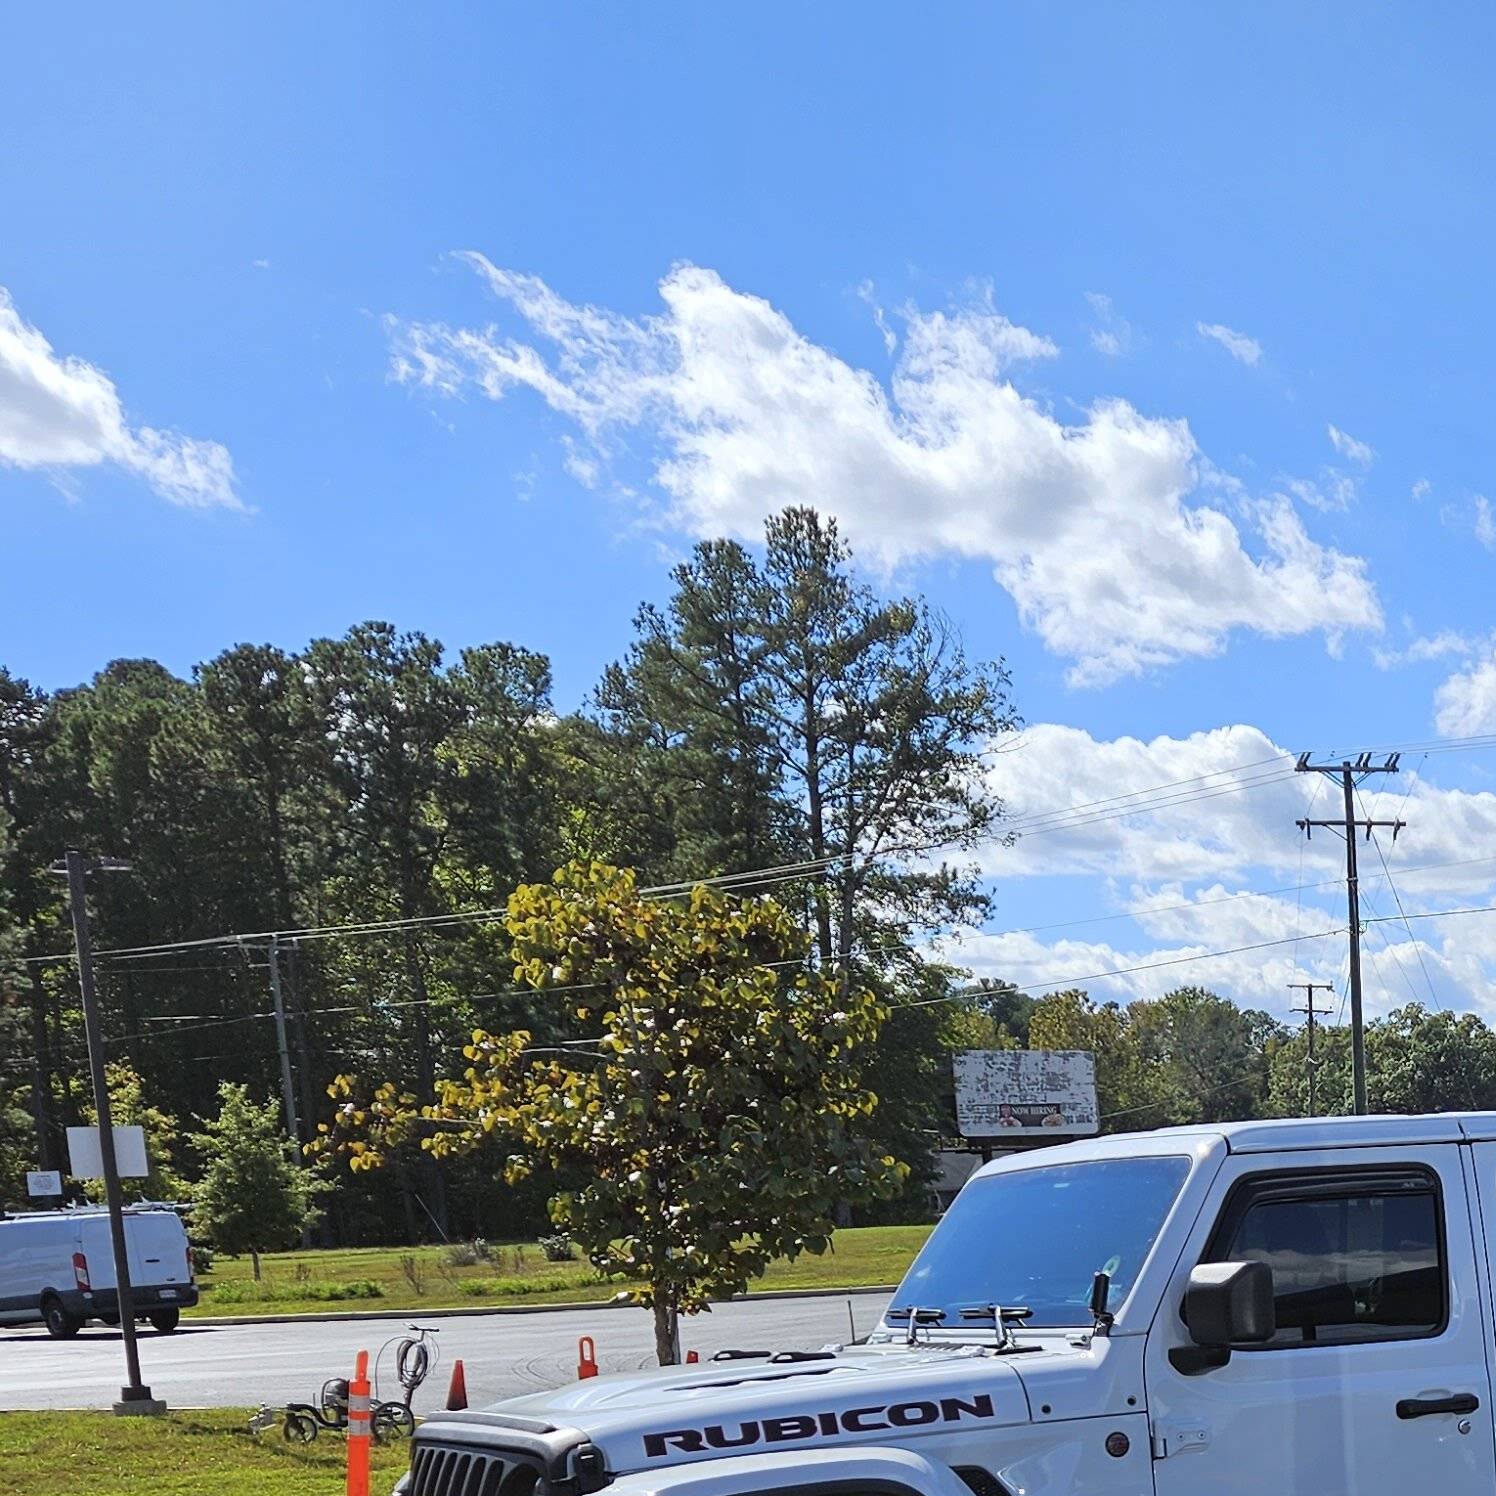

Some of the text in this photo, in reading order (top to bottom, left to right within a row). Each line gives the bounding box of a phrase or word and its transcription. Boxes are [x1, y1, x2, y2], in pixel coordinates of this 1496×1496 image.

[1011, 1106, 1057, 1115] NOW HIRING
[643, 1394, 995, 1457] RUBICON
